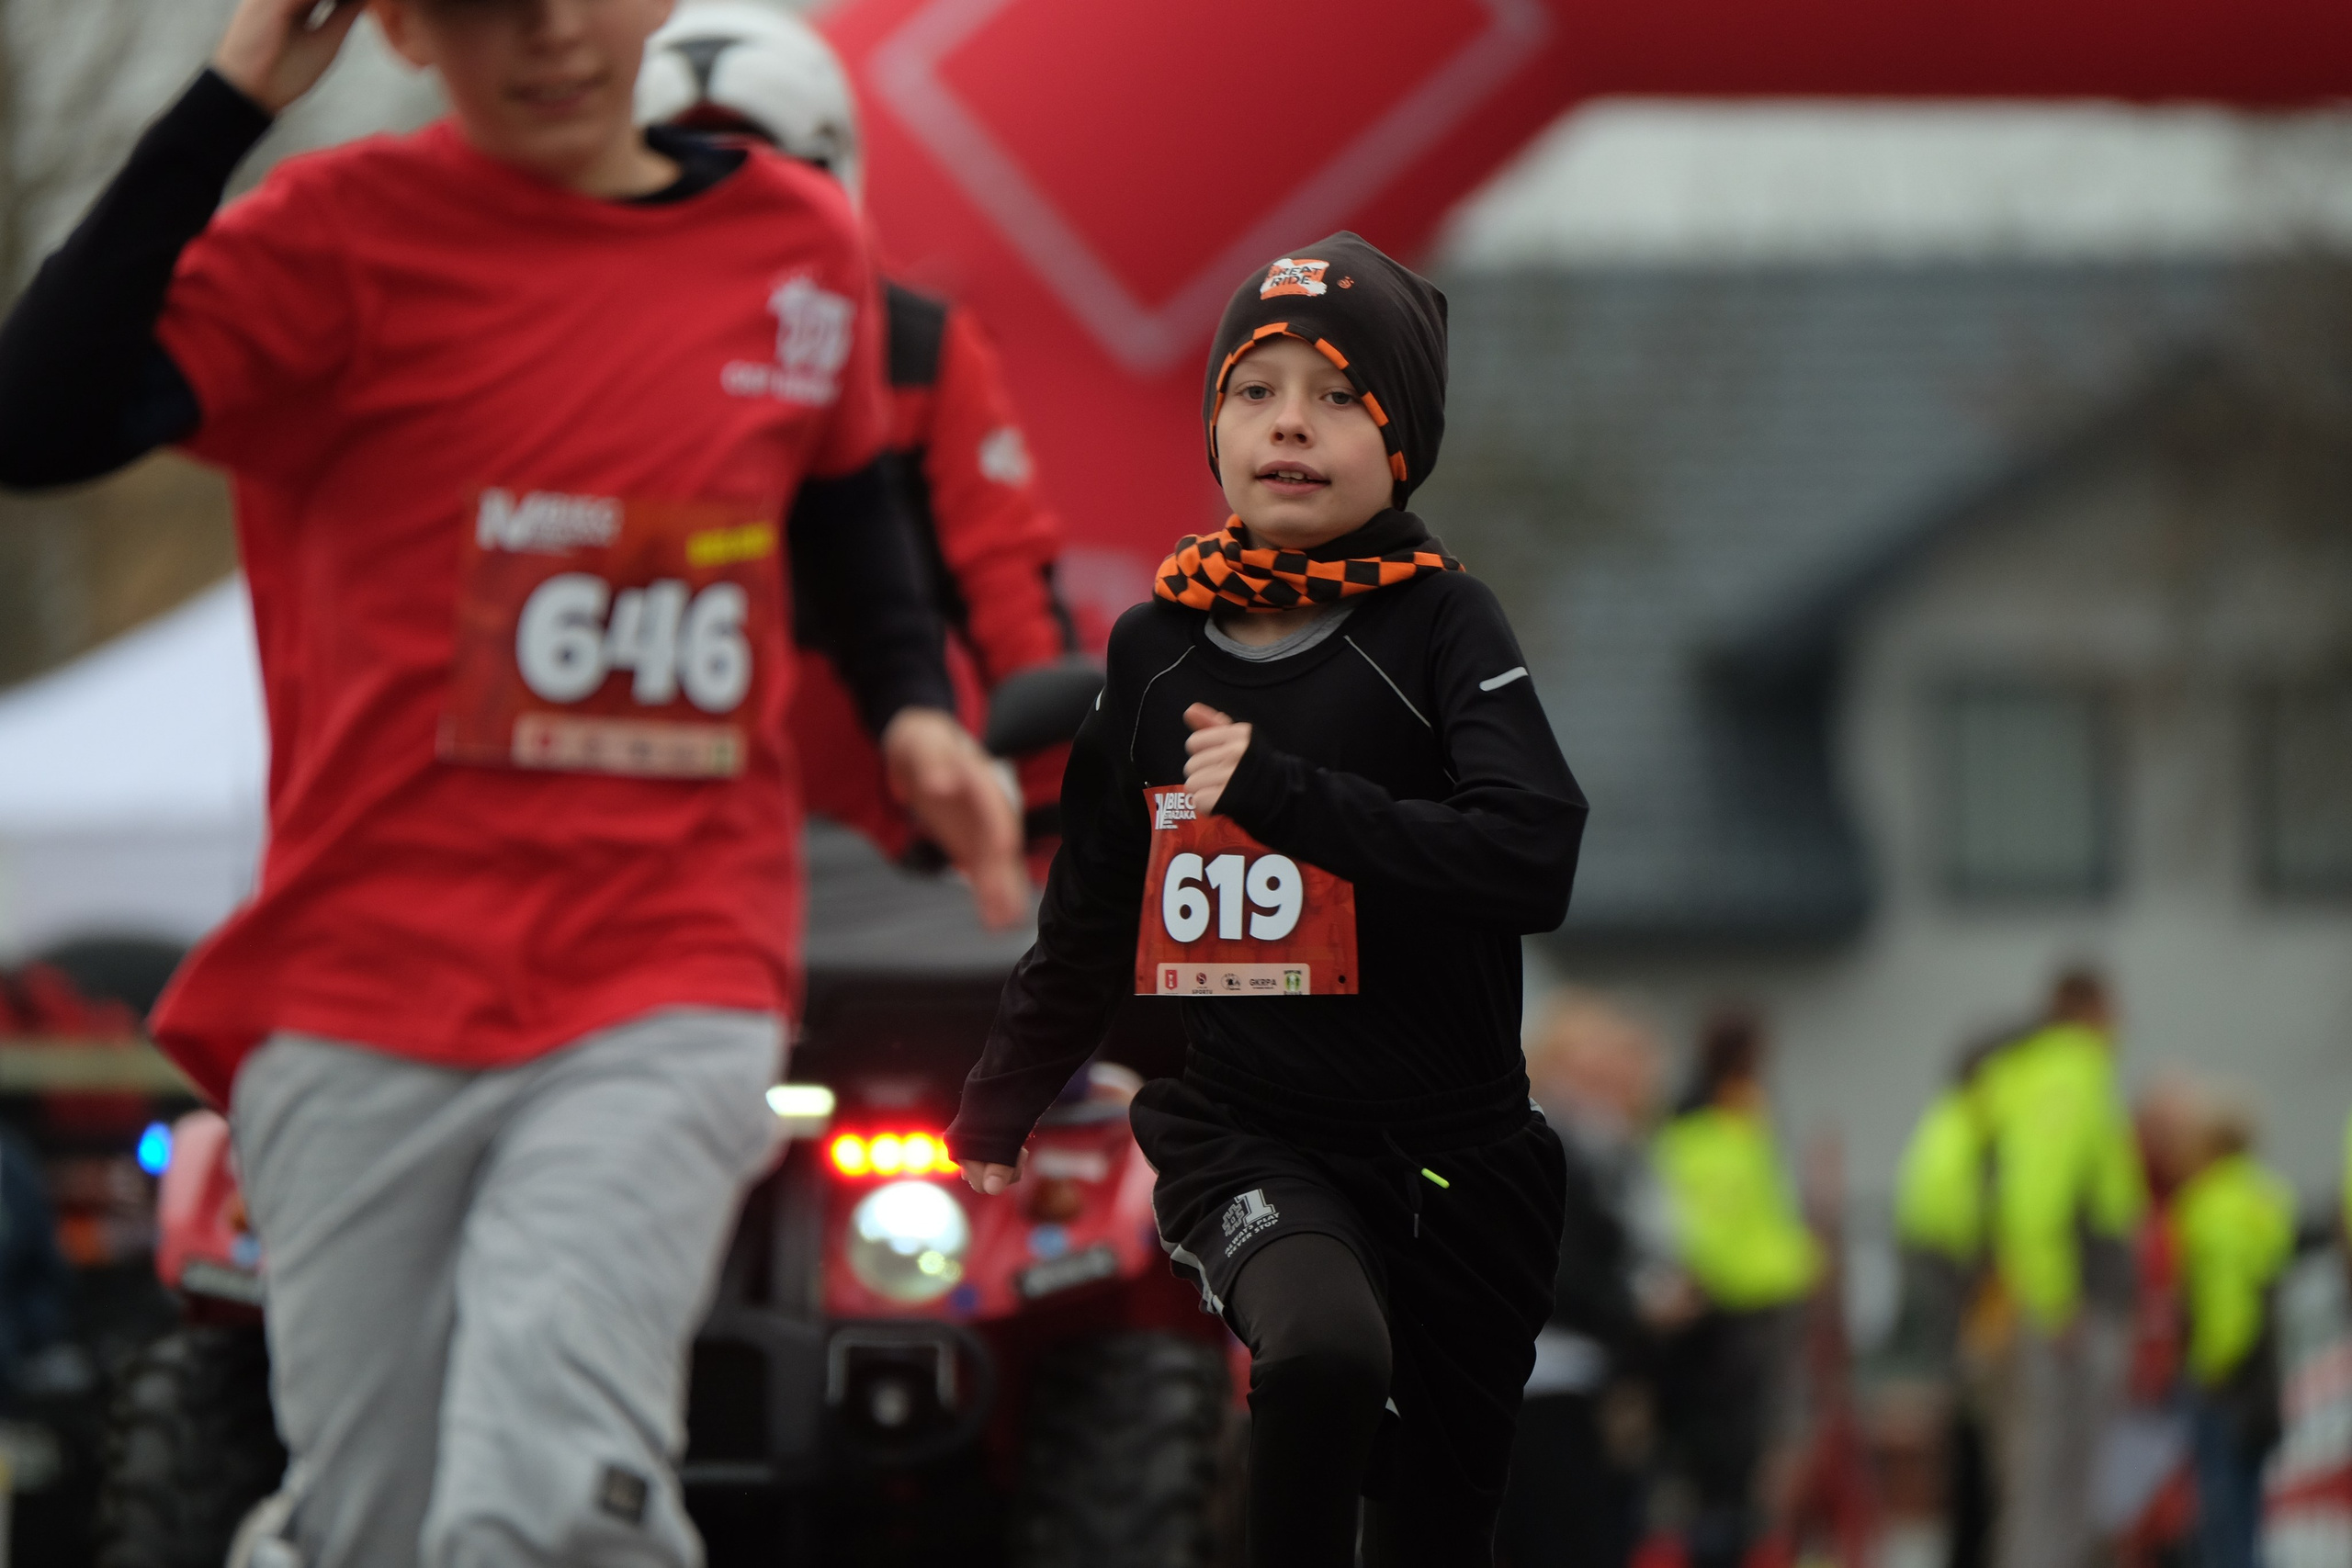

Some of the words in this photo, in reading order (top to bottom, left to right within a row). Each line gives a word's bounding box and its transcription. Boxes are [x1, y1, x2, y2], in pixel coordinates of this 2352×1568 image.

[1271, 276, 1310, 287] RIDE
[517, 571, 752, 714] 646
[1163, 852, 1303, 942] 619
[1249, 978, 1277, 987] GKRPA
[1225, 1224, 1254, 1254] ALWAYS
[1256, 1213, 1280, 1225] PLAY
[1227, 1232, 1252, 1258] NEVER
[1254, 1219, 1278, 1233] STOP
